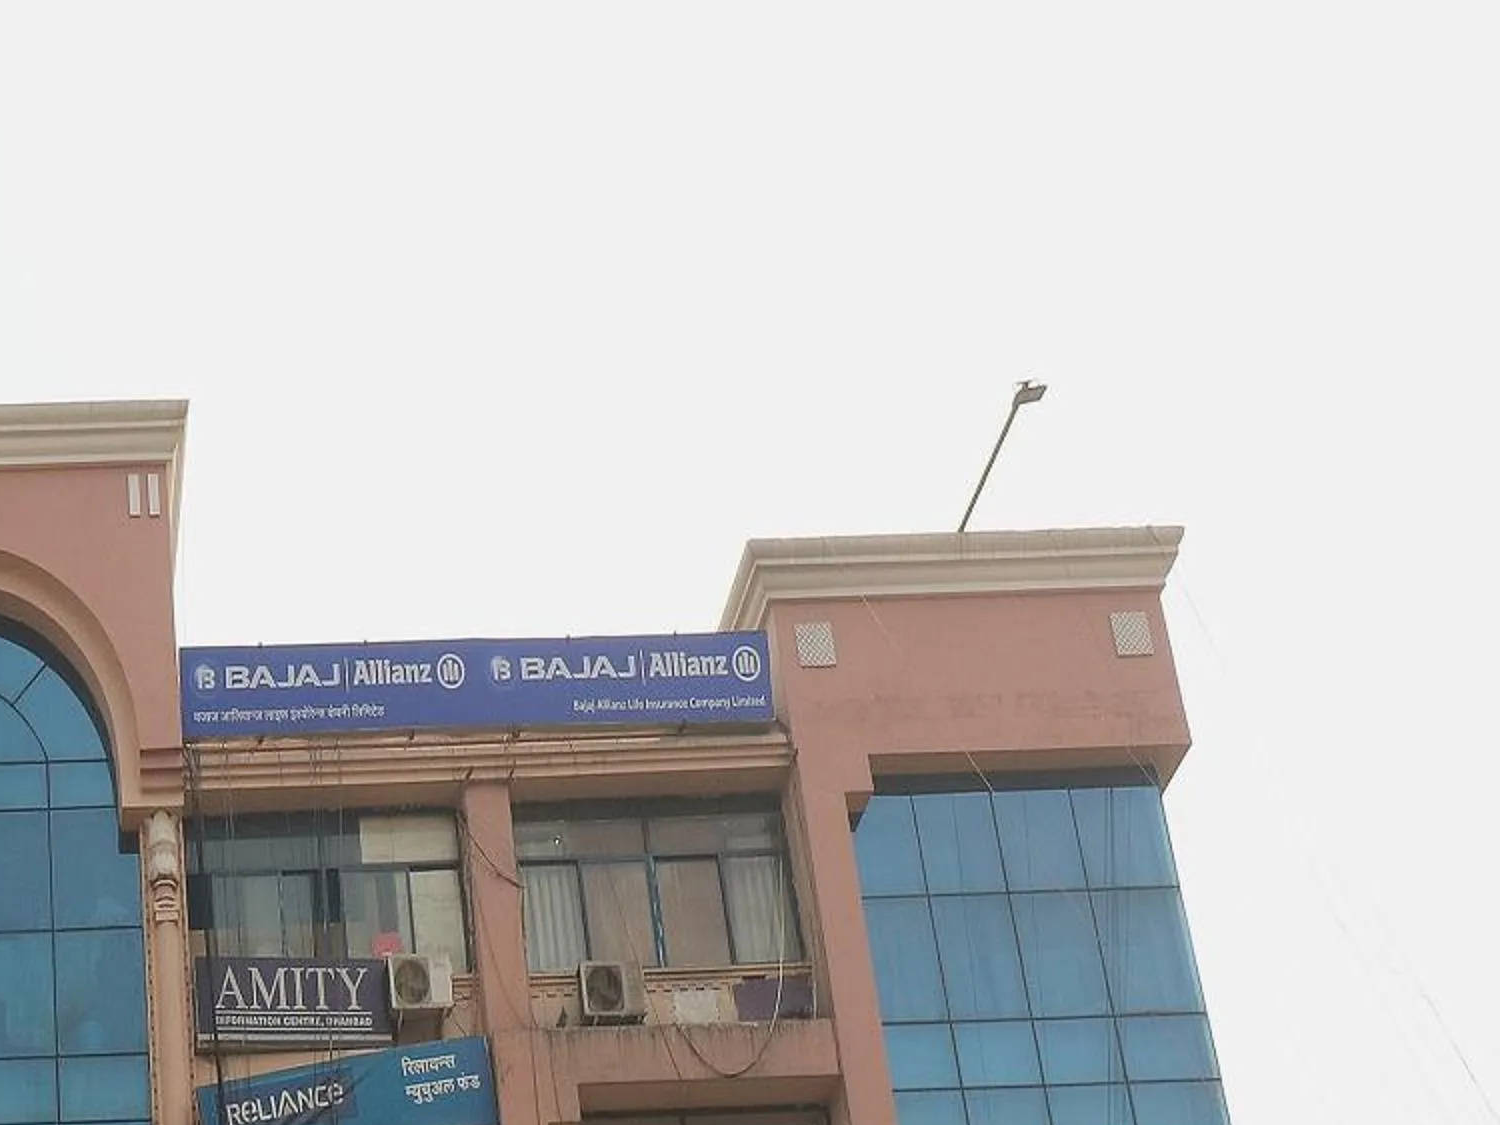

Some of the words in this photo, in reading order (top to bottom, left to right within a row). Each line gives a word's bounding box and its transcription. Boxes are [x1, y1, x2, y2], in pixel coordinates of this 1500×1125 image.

[225, 664, 340, 689] BAJAJ
[353, 656, 432, 686] Allianz
[520, 654, 636, 680] BAJAJ
[648, 647, 728, 680] Allianz
[690, 697, 730, 712] Company
[215, 966, 369, 1010] AMITY
